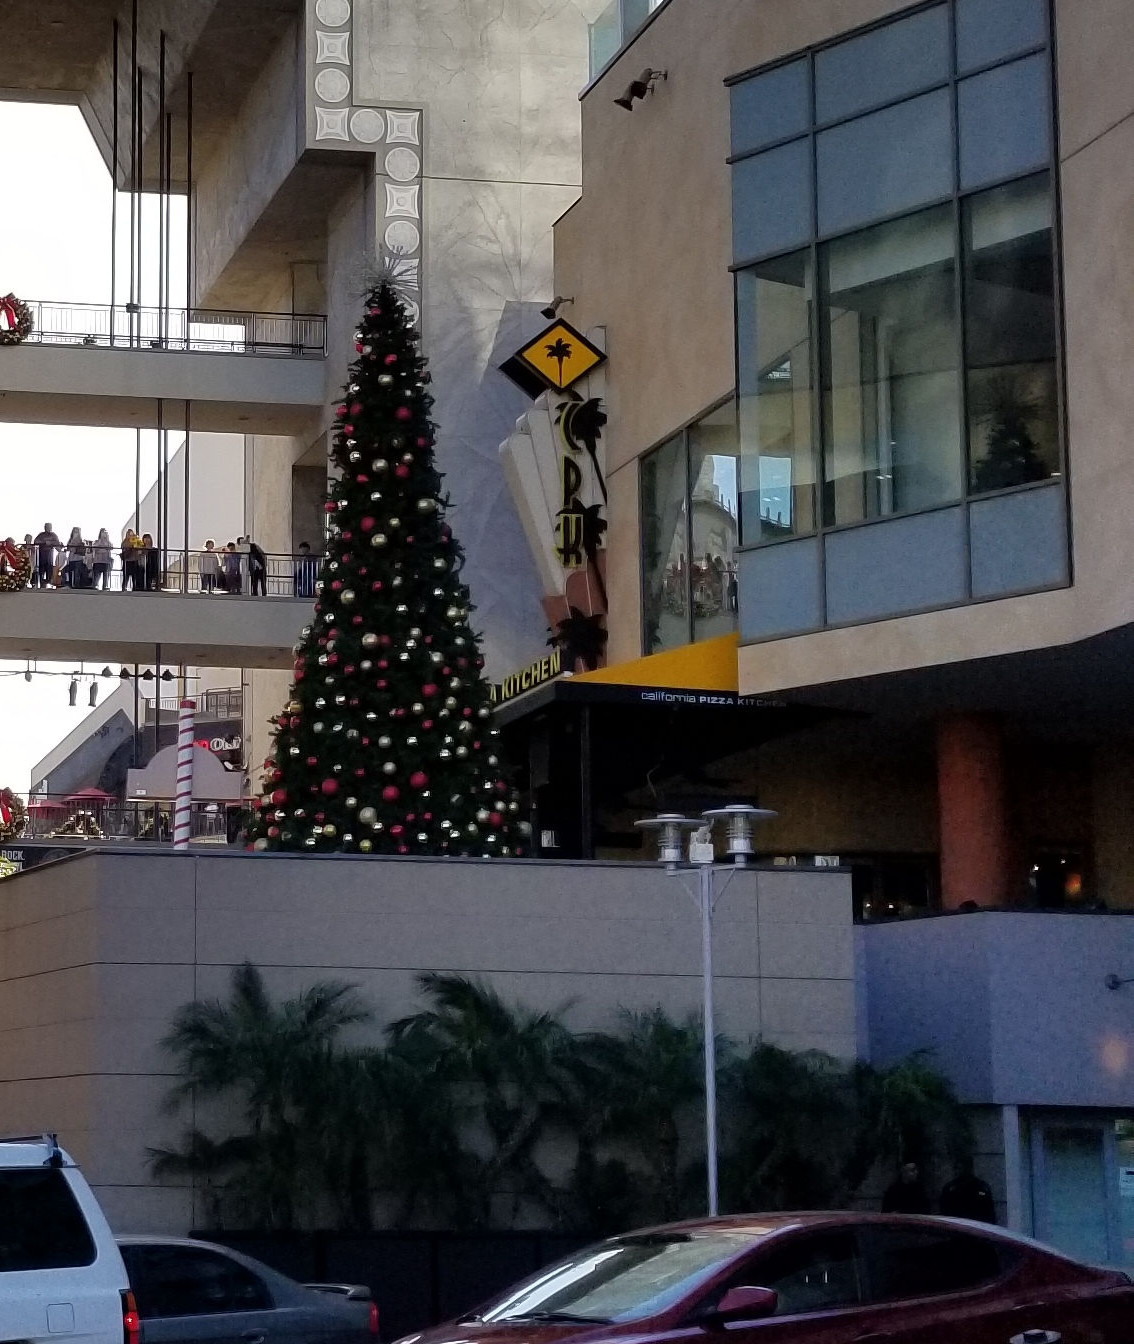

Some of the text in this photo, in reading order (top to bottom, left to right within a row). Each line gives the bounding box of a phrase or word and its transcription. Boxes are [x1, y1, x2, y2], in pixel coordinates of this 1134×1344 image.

[502, 644, 561, 701] KITCHEN
[641, 691, 697, 703] california
[699, 696, 734, 705] PIZZA
